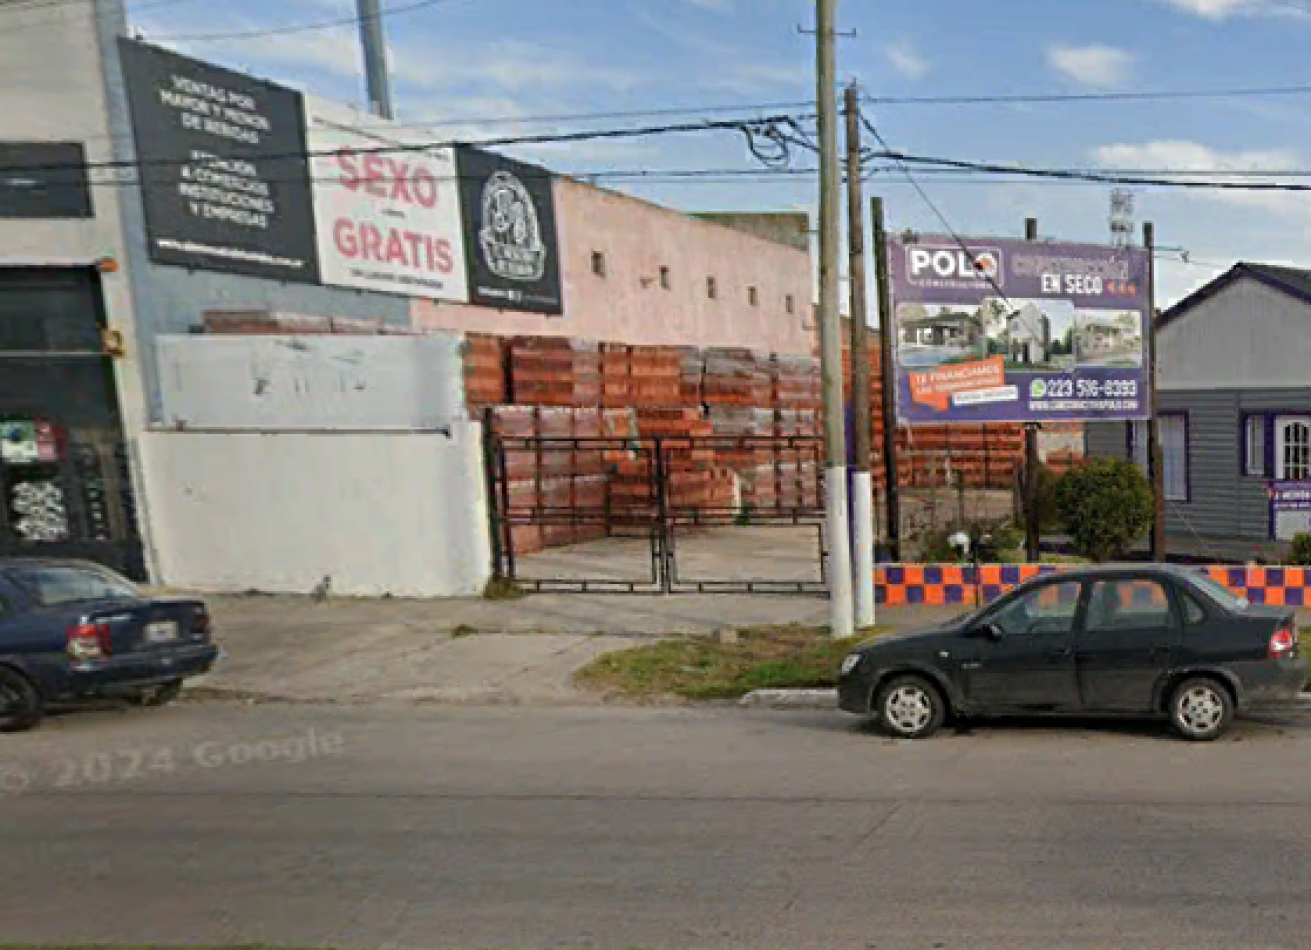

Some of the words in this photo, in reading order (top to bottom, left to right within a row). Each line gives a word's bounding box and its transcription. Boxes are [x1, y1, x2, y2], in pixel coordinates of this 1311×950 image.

[159, 88, 210, 115] MAYOR
[223, 107, 270, 131] MENOR
[181, 112, 203, 129] DE
[204, 119, 260, 144] BEBIDAS
[336, 144, 438, 209] SEXO
[332, 216, 455, 276] GRATIS
[910, 249, 998, 278] POLO
[1040, 272, 1061, 294] EN
[1064, 273, 1103, 296] SECO
[1047, 378, 1072, 398] 223
